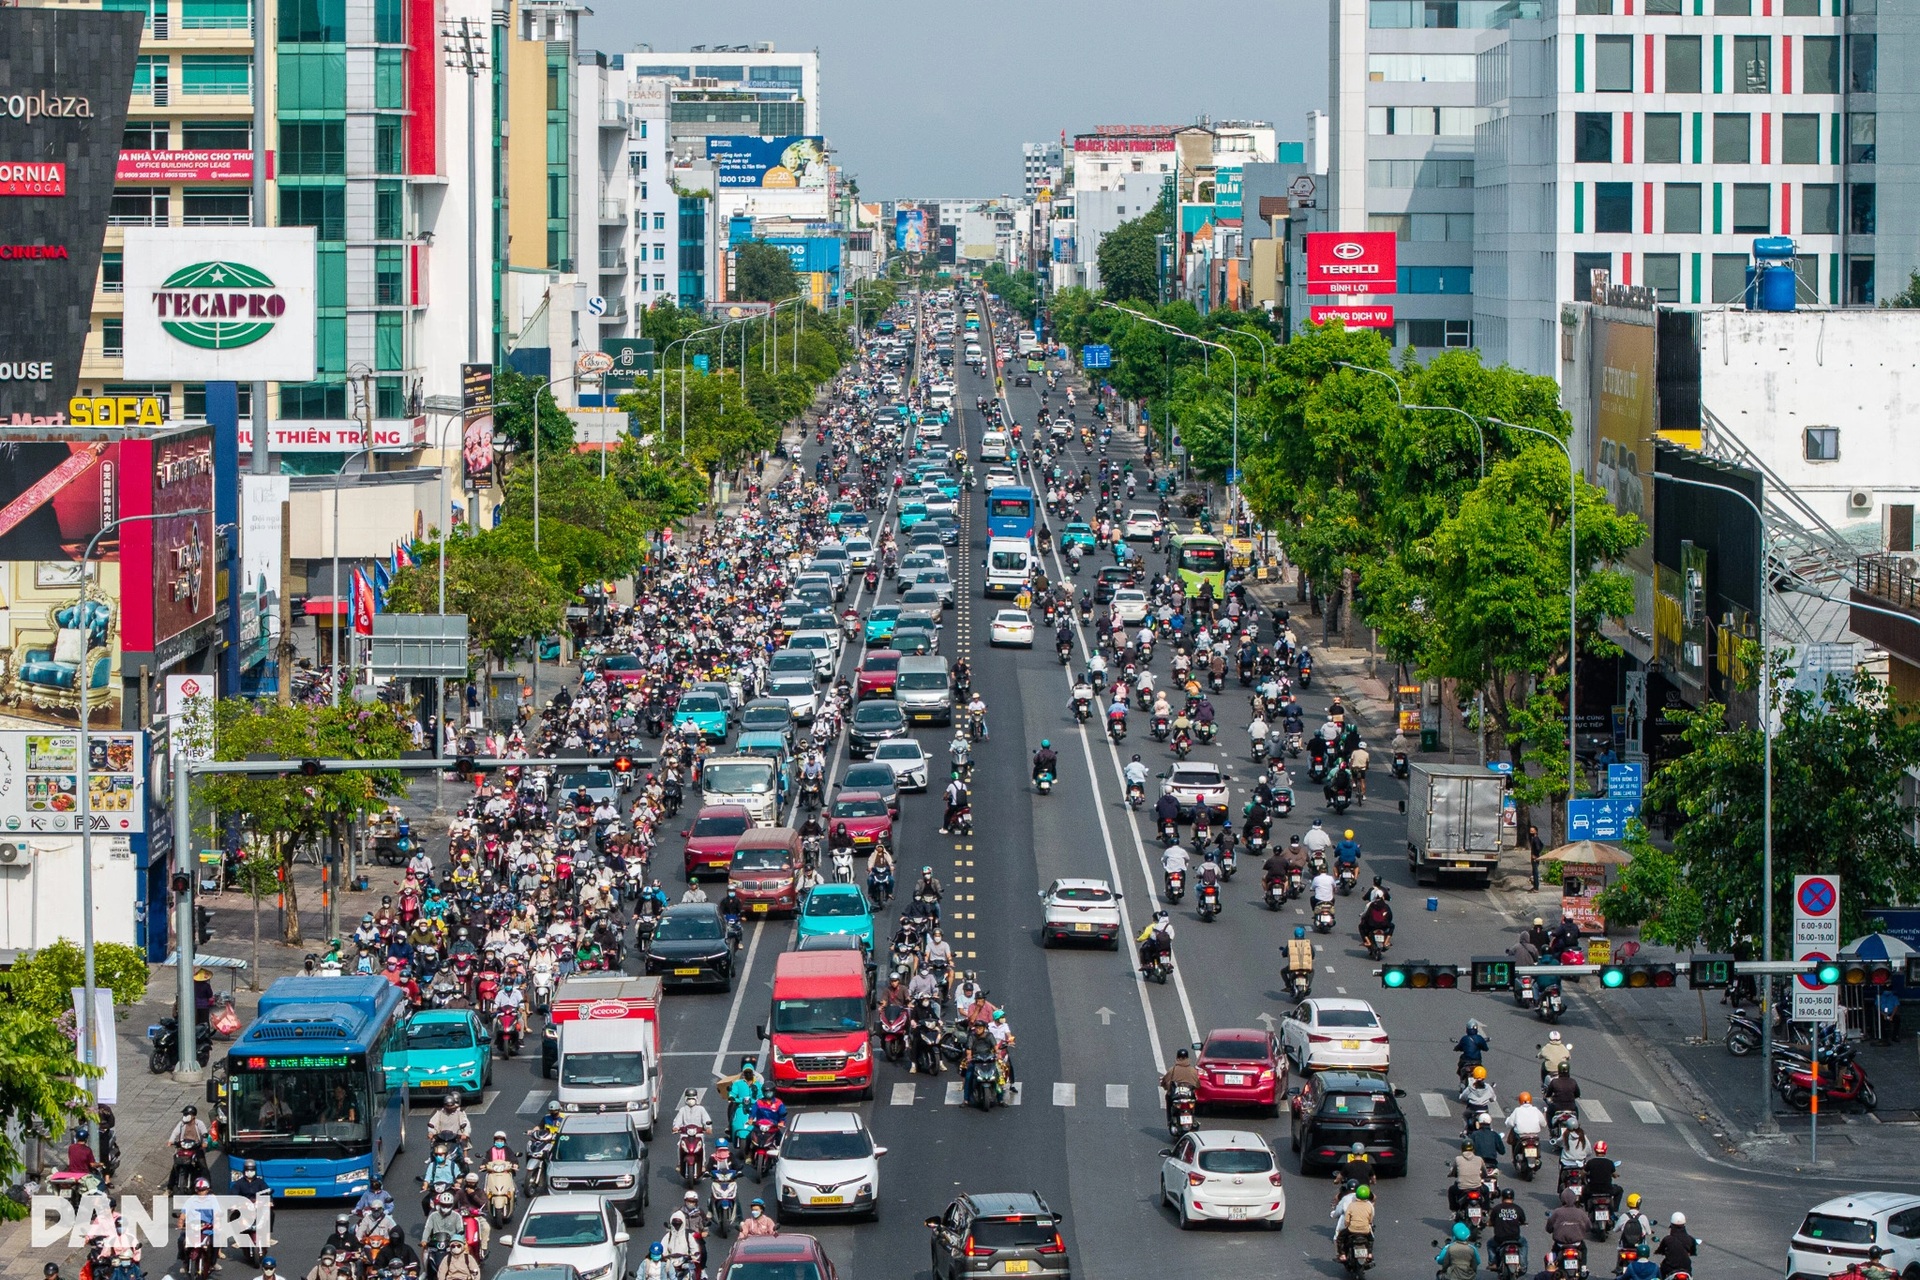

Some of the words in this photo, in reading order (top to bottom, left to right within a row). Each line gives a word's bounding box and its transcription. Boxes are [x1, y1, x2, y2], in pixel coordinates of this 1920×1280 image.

[130, 151, 151, 161] NHÀ
[175, 151, 208, 161] PHÒNG
[210, 152, 231, 161] CHO
[233, 152, 254, 161] THU
[719, 175, 736, 183] 1800
[738, 175, 756, 183] 1299
[25, 184, 61, 192] YOGA
[1216, 181, 1239, 193] XUÂN
[0, 245, 68, 259] CINEMA
[1319, 264, 1379, 274] TERACO
[1330, 283, 1351, 292] BÌNH
[1353, 283, 1368, 293] LỢI
[152, 292, 286, 318] TECAPRO
[1352, 312, 1372, 322] DỊCH
[1375, 312, 1387, 322] VỤ
[0, 362, 53, 380] OUSE
[607, 368, 625, 377] LỘC
[625, 367, 648, 376] PHÚC
[69, 397, 164, 425] SOFA
[276, 427, 331, 444] THIÊN
[336, 431, 400, 444] TRANG
[74, 815, 110, 831] FDA
[1798, 933, 1834, 941] 16.00-19.00
[1487, 963, 1508, 984] 19
[1706, 961, 1727, 982] 19
